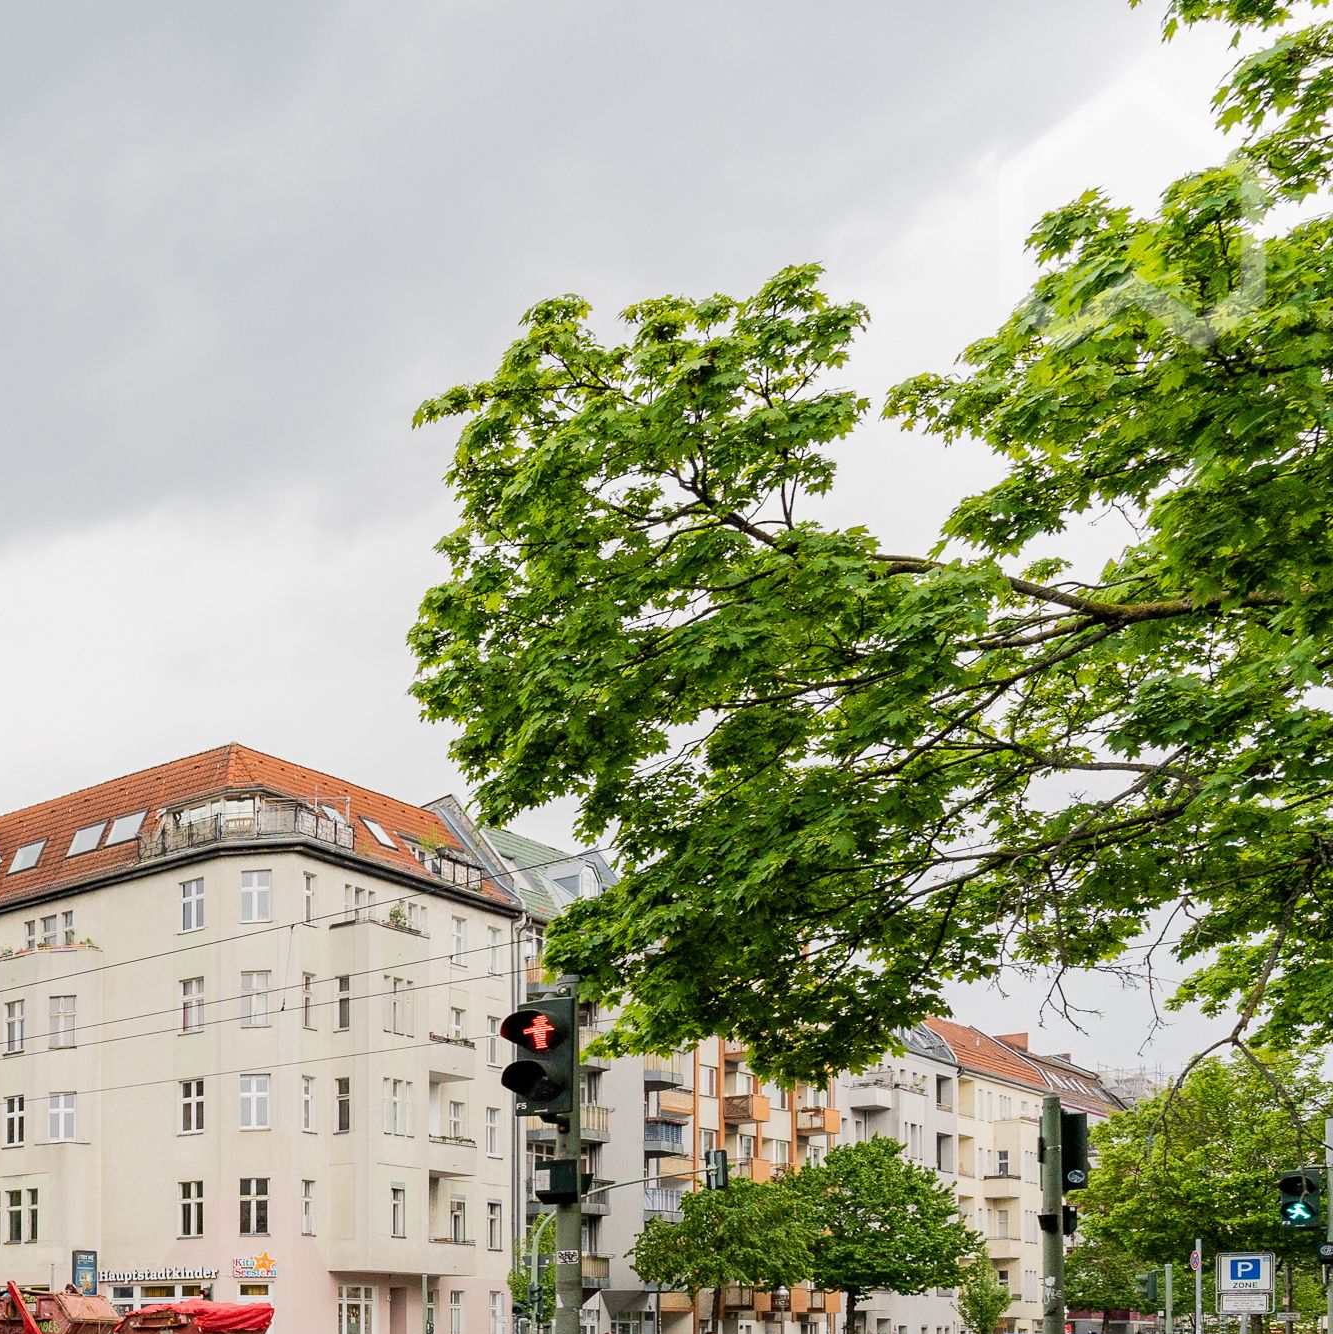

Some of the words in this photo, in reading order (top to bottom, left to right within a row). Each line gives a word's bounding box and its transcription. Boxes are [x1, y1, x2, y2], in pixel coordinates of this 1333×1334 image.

[516, 1102, 527, 1110] F5
[234, 1258, 255, 1267] Kita
[234, 1268, 277, 1278] Seestern
[1237, 1261, 1253, 1278] P
[98, 1267, 218, 1284] Hauptstadtkinder
